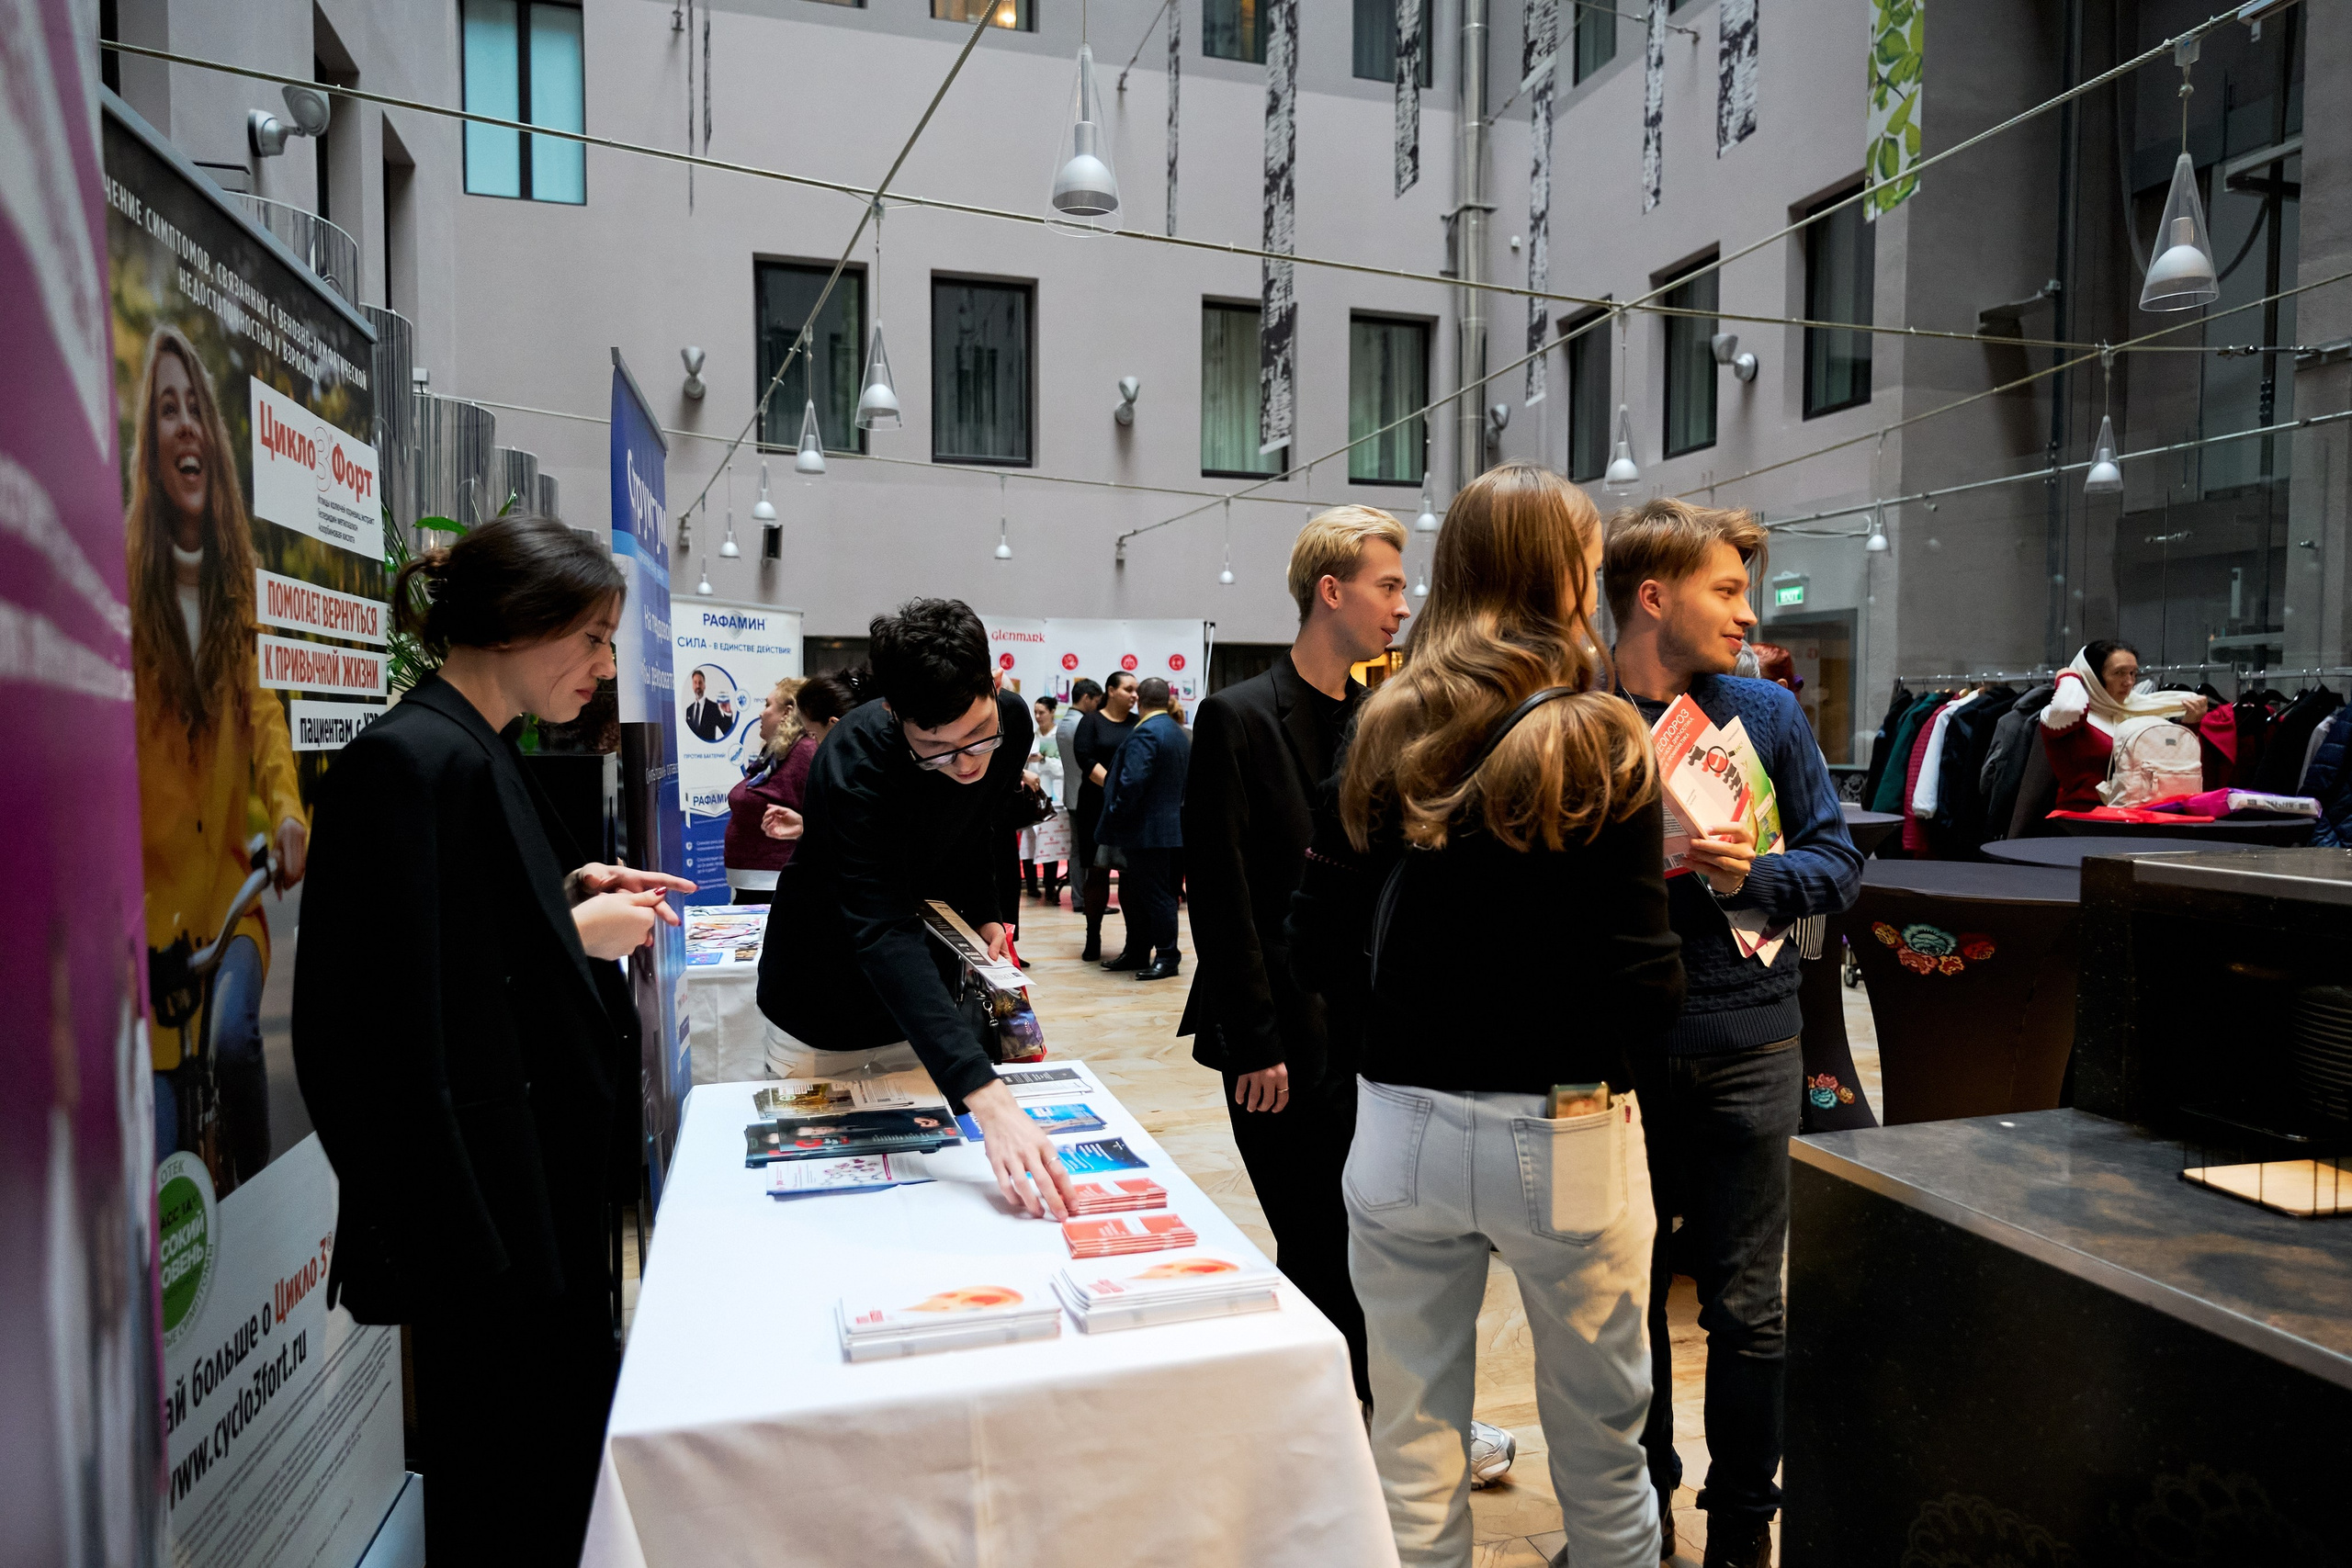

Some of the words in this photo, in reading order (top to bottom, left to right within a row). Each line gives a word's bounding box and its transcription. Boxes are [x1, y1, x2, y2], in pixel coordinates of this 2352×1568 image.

[146, 208, 214, 283] СИМПТОМОВ,
[217, 262, 268, 320] СВЯЗАННЫХ
[271, 303, 276, 324] С
[278, 308, 368, 391] ВЕНОЗНО-ЛИМФАТИЧЕСКОЙ
[275, 334, 280, 356] У
[283, 340, 320, 384] ВЗРОСЛЫХ
[267, 580, 321, 626] ПОМОГАЕТ
[322, 594, 378, 637] ВЕРНУТЬСЯ
[703, 613, 765, 630] РАФАМИН
[265, 644, 273, 680] К
[276, 646, 340, 686] ПРИВЫЧНОЙ
[342, 656, 379, 689] ЖИЗНИ
[677, 636, 707, 649] СИЛА
[719, 643, 754, 652] ЕДИНСТВЕ
[300, 717, 353, 748] пациентам
[161, 1209, 205, 1264] СОКИЙ
[162, 1242, 204, 1290] ОВЕНЬ
[192, 1314, 258, 1408] больше
[263, 1302, 271, 1337] о
[275, 1255, 318, 1325] Цикло
